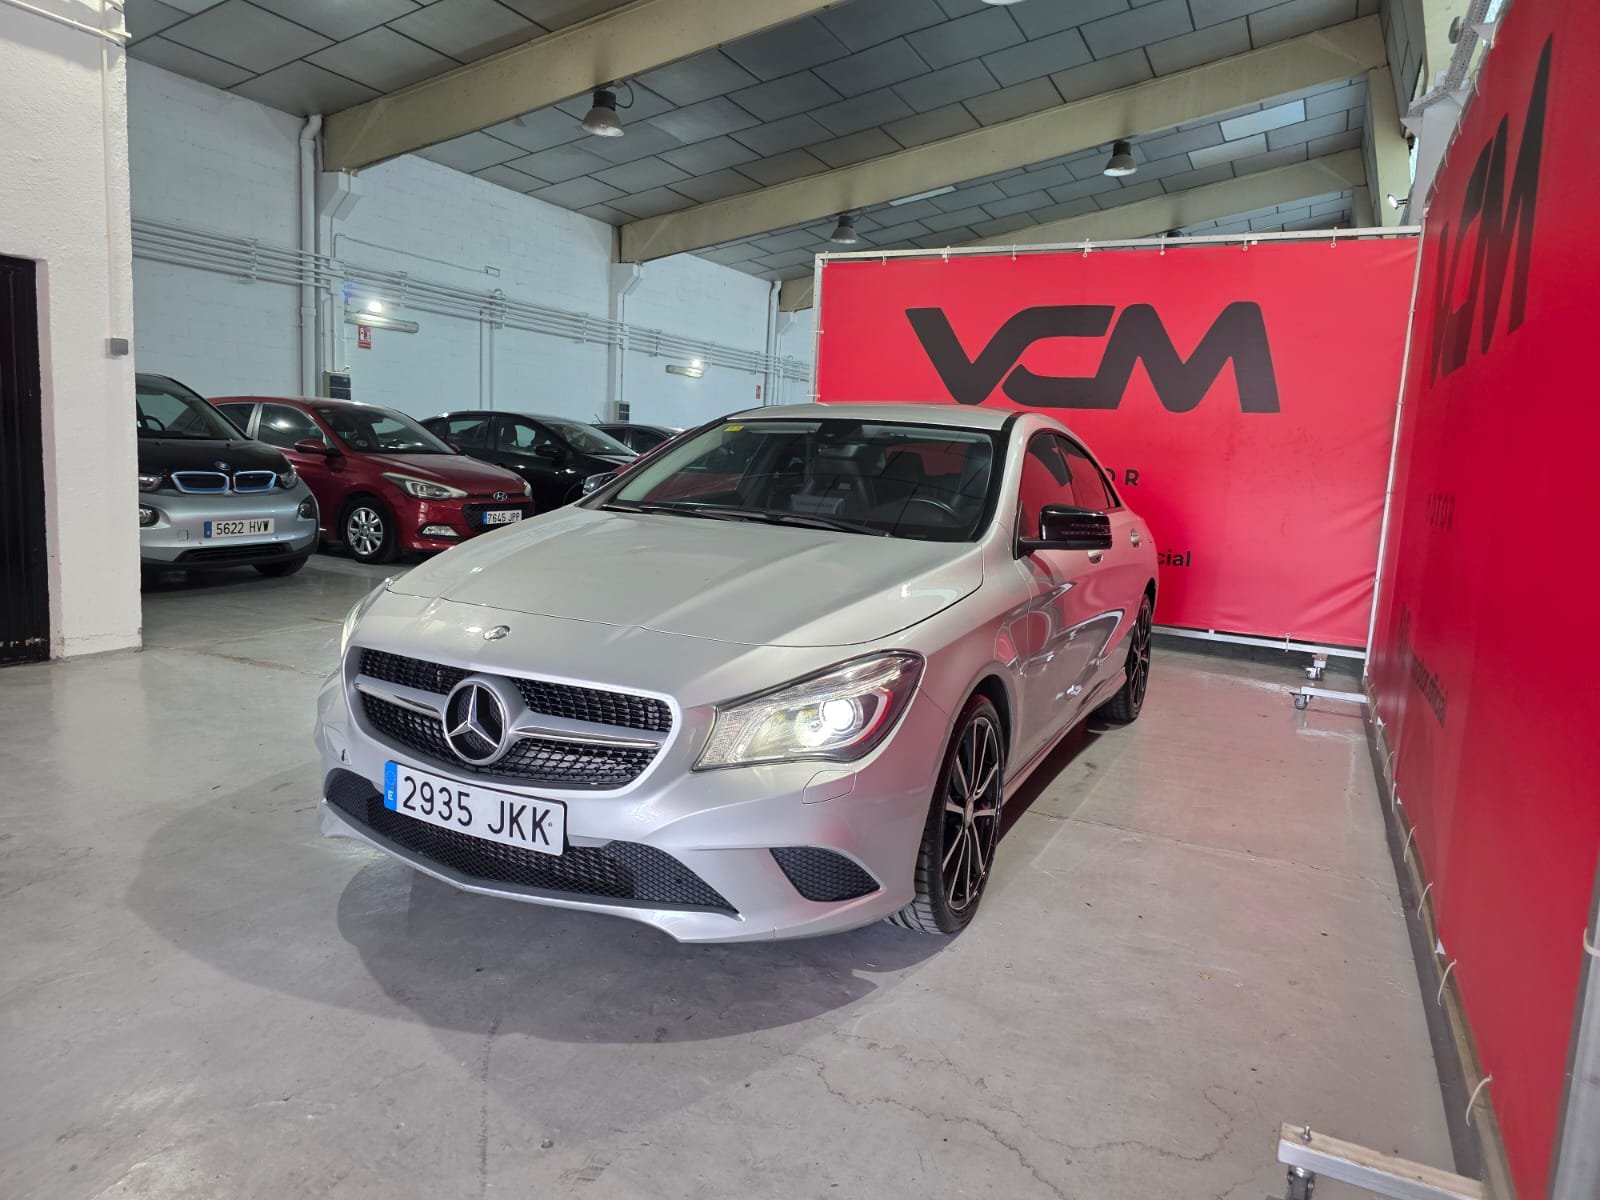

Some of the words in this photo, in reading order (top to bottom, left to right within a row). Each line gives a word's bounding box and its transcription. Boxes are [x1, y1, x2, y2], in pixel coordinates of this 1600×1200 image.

[1430, 31, 1553, 390] VCM
[904, 301, 1281, 413] VCM
[216, 521, 244, 535] 5622
[249, 519, 270, 533] HVW
[487, 512, 507, 523] 7645
[402, 775, 473, 827] 2935
[487, 800, 551, 846] JKK
